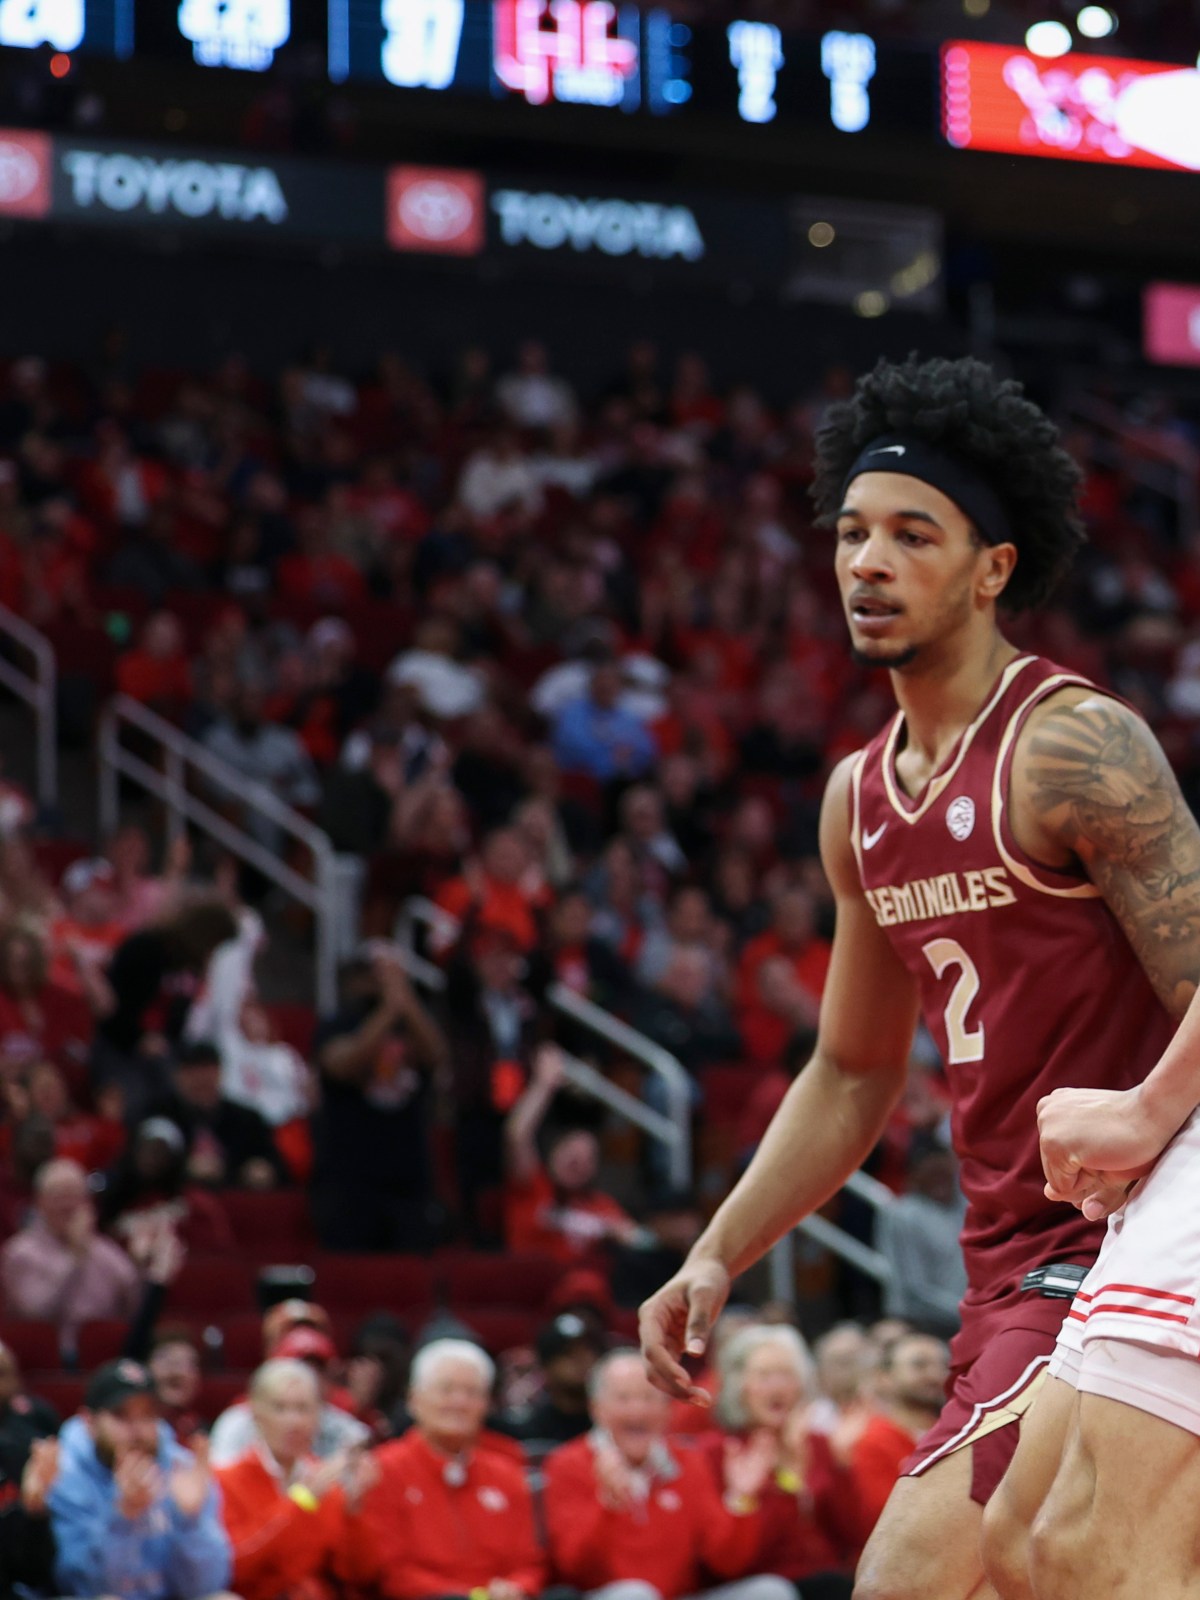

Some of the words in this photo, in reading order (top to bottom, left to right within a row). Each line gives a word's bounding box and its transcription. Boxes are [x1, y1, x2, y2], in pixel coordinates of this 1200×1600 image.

[61, 150, 289, 225] TOYOTA
[491, 188, 704, 262] TOYOTA
[921, 937, 985, 1065] 2
